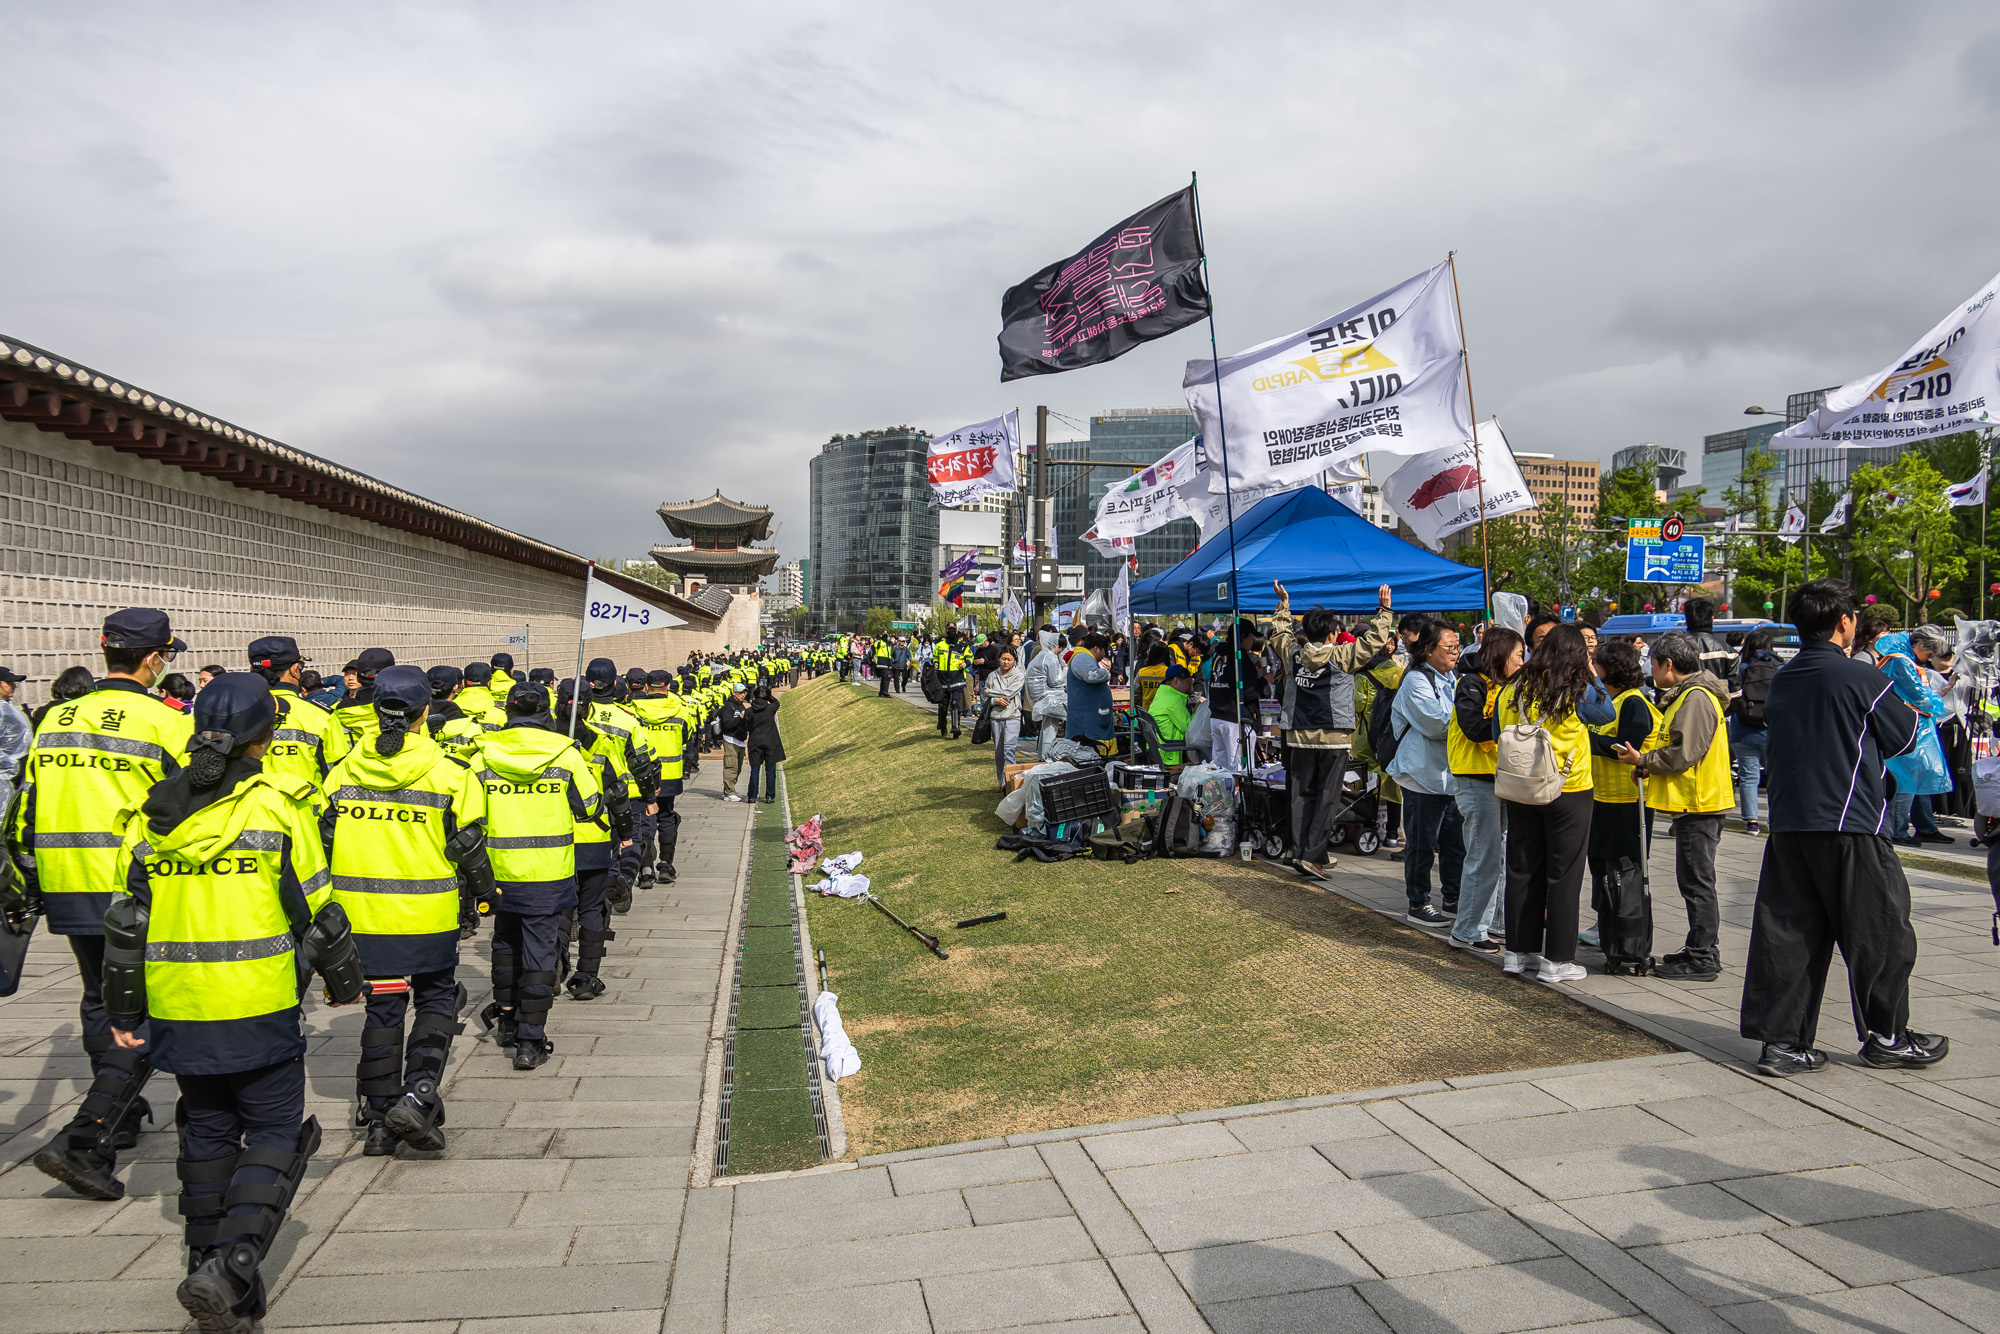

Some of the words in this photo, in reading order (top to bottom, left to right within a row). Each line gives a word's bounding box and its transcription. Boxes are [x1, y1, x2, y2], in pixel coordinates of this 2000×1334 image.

[1667, 524, 1679, 536] 40
[590, 601, 651, 625] 82기-3
[509, 636, 526, 644] 82기-2
[39, 753, 131, 772] POLICE
[487, 782, 561, 795] POLICE
[338, 805, 427, 824] POLICE
[145, 857, 258, 879] POLICE
